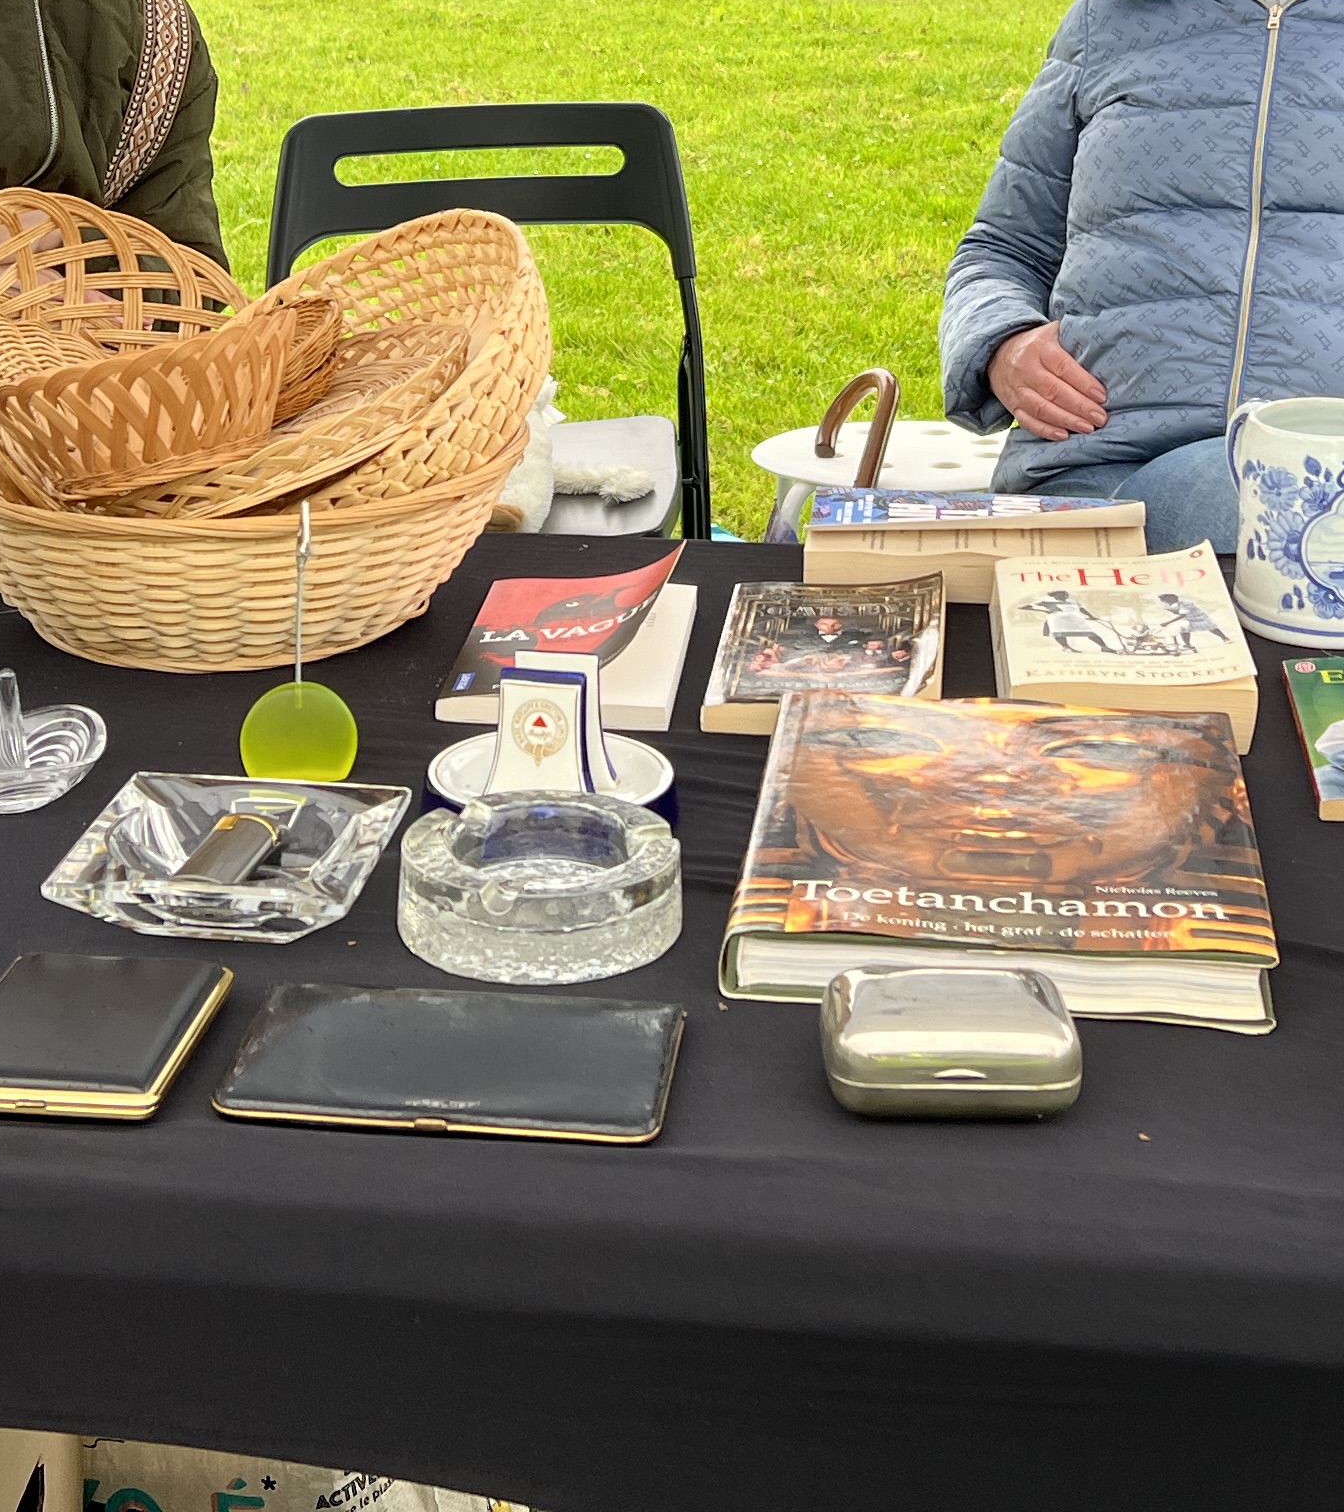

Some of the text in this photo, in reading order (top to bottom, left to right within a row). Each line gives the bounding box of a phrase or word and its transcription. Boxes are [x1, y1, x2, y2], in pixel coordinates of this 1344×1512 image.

[1010, 567, 1207, 588] The Help
[479, 628, 530, 644] LA
[1024, 669, 1127, 679] KATHRYN
[791, 878, 1231, 922] Toetanchamon
[1094, 884, 1219, 898] Nicholas Reeves
[876, 912, 948, 933] koning
[963, 921, 995, 935] het
[1001, 925, 1044, 940] graf
[1059, 925, 1086, 940] de
